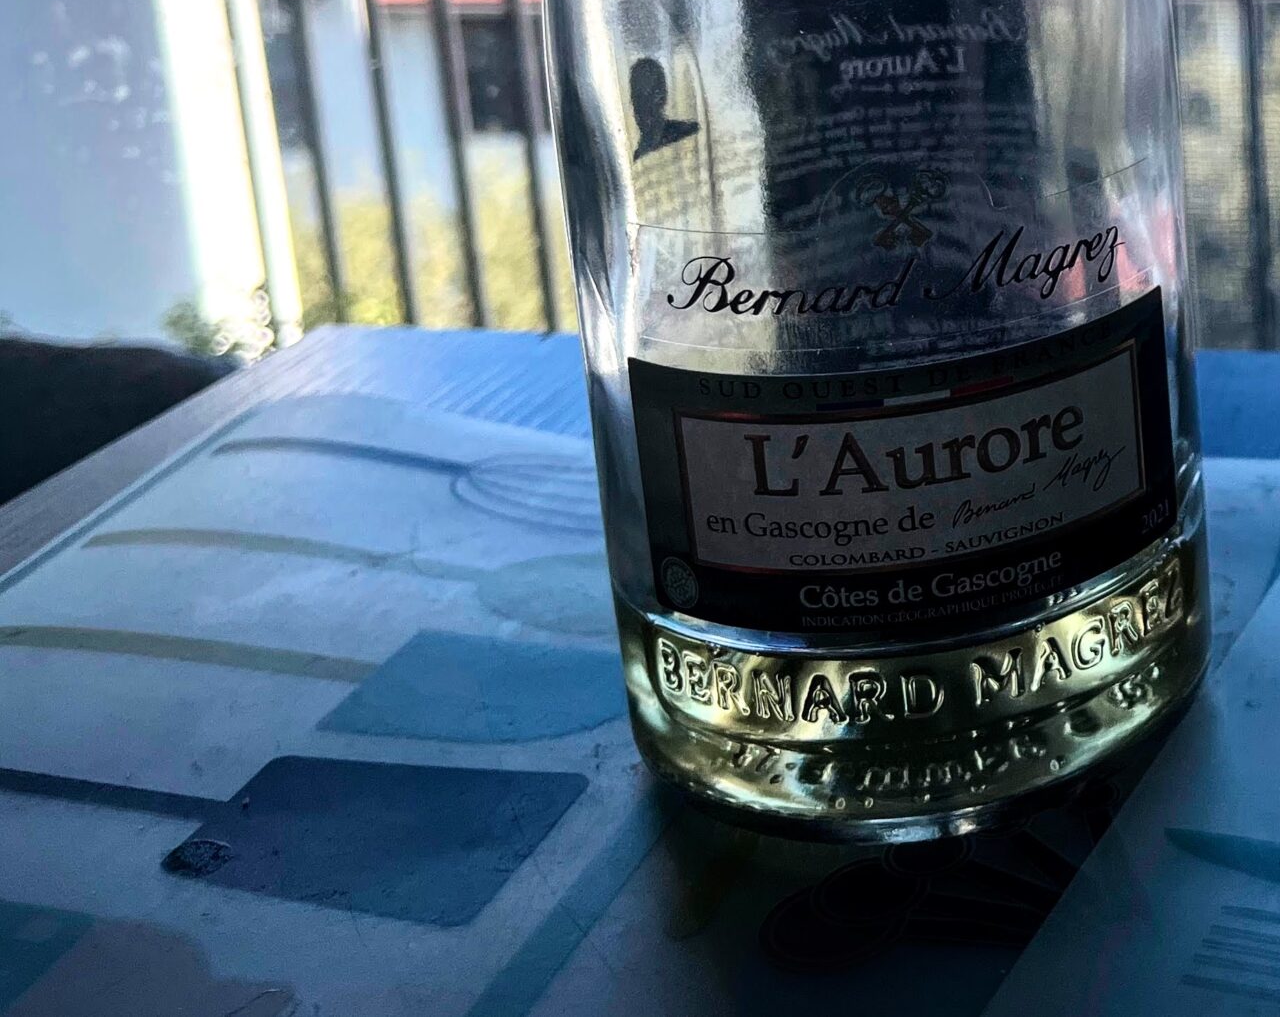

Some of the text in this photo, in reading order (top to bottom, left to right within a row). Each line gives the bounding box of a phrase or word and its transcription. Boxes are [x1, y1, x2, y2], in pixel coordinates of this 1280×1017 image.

[668, 224, 1124, 315] Bernard Magrez
[699, 378, 762, 400] SUD
[783, 374, 906, 400] OUEST
[744, 404, 1085, 496] L'Aurore
[706, 514, 739, 535] en
[745, 512, 889, 545] Gascogne
[898, 507, 935, 533] de
[789, 545, 926, 567] COLOMBARD
[945, 511, 1066, 553] SAUVIGNON
[799, 551, 1063, 609] Côtes de Gascogne
[656, 560, 1184, 725] BERNARD MAGREZ
[801, 614, 884, 628] INDICATION
